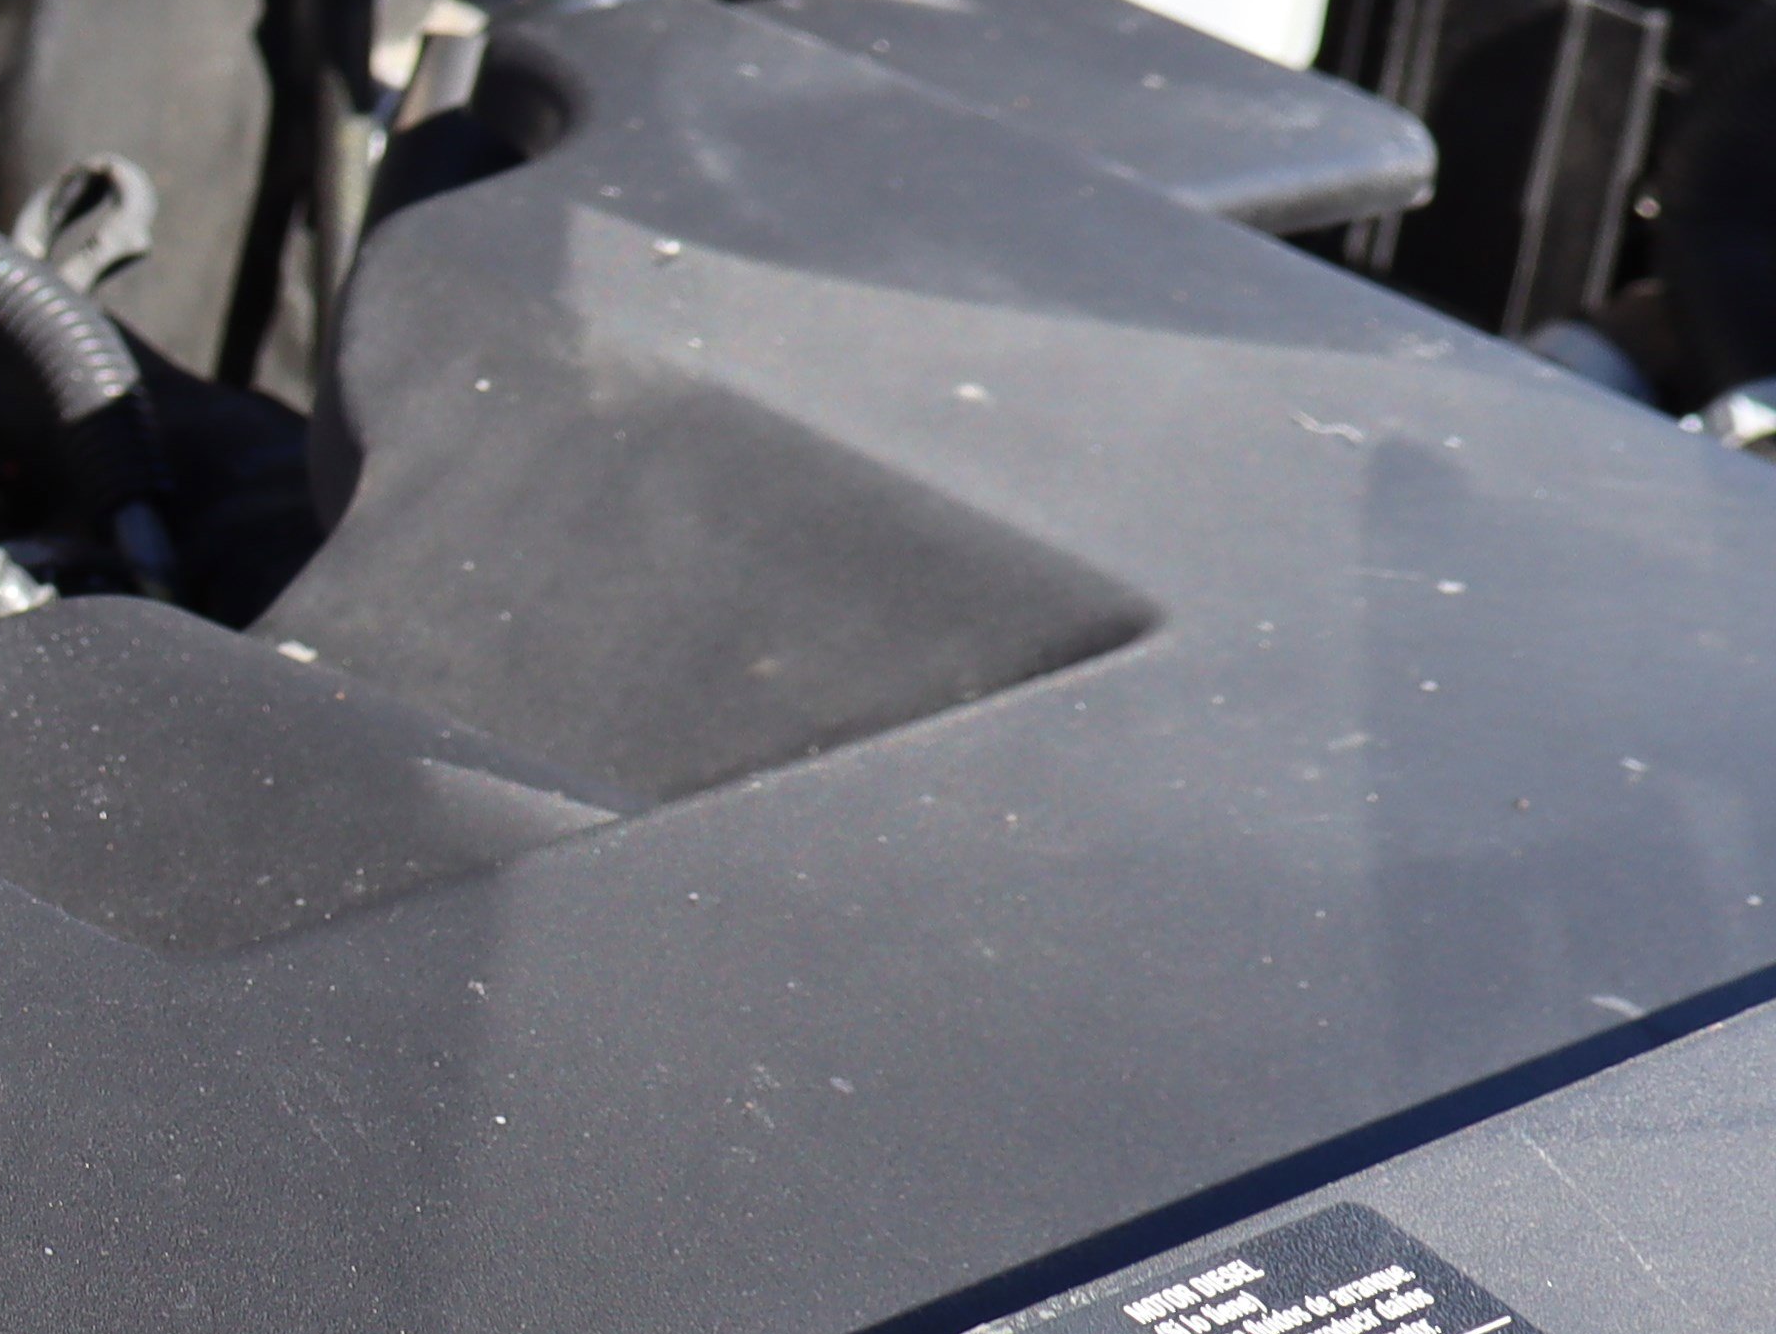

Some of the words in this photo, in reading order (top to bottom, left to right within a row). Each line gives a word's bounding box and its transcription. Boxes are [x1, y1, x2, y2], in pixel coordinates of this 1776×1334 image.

[1122, 1282, 1202, 1325] MOTOR
[1187, 1257, 1265, 1298] DIESEL
[1177, 1313, 1212, 1334] lo
[1199, 1288, 1268, 1326] tiene)
[1303, 1294, 1336, 1317] de
[1328, 1263, 1416, 1307] arranque.
[1373, 1286, 1435, 1321] daños
